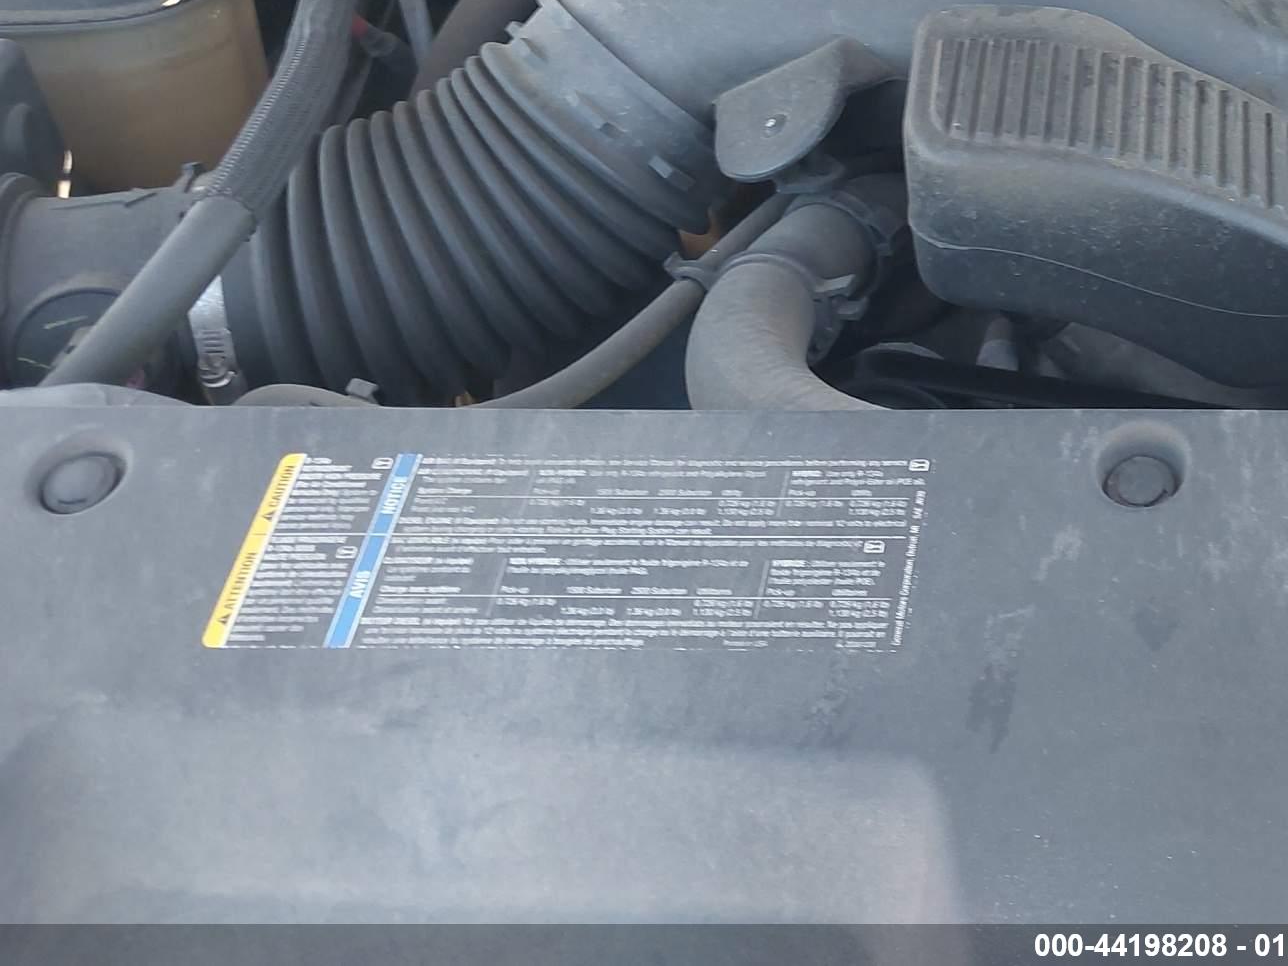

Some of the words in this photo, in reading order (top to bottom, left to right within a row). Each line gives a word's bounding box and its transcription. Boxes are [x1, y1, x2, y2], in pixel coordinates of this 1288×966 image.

[270, 465, 295, 509] CAUTION
[380, 476, 408, 514] NOTICE
[223, 551, 258, 612] ATTENTION
[349, 570, 372, 598] AVIS
